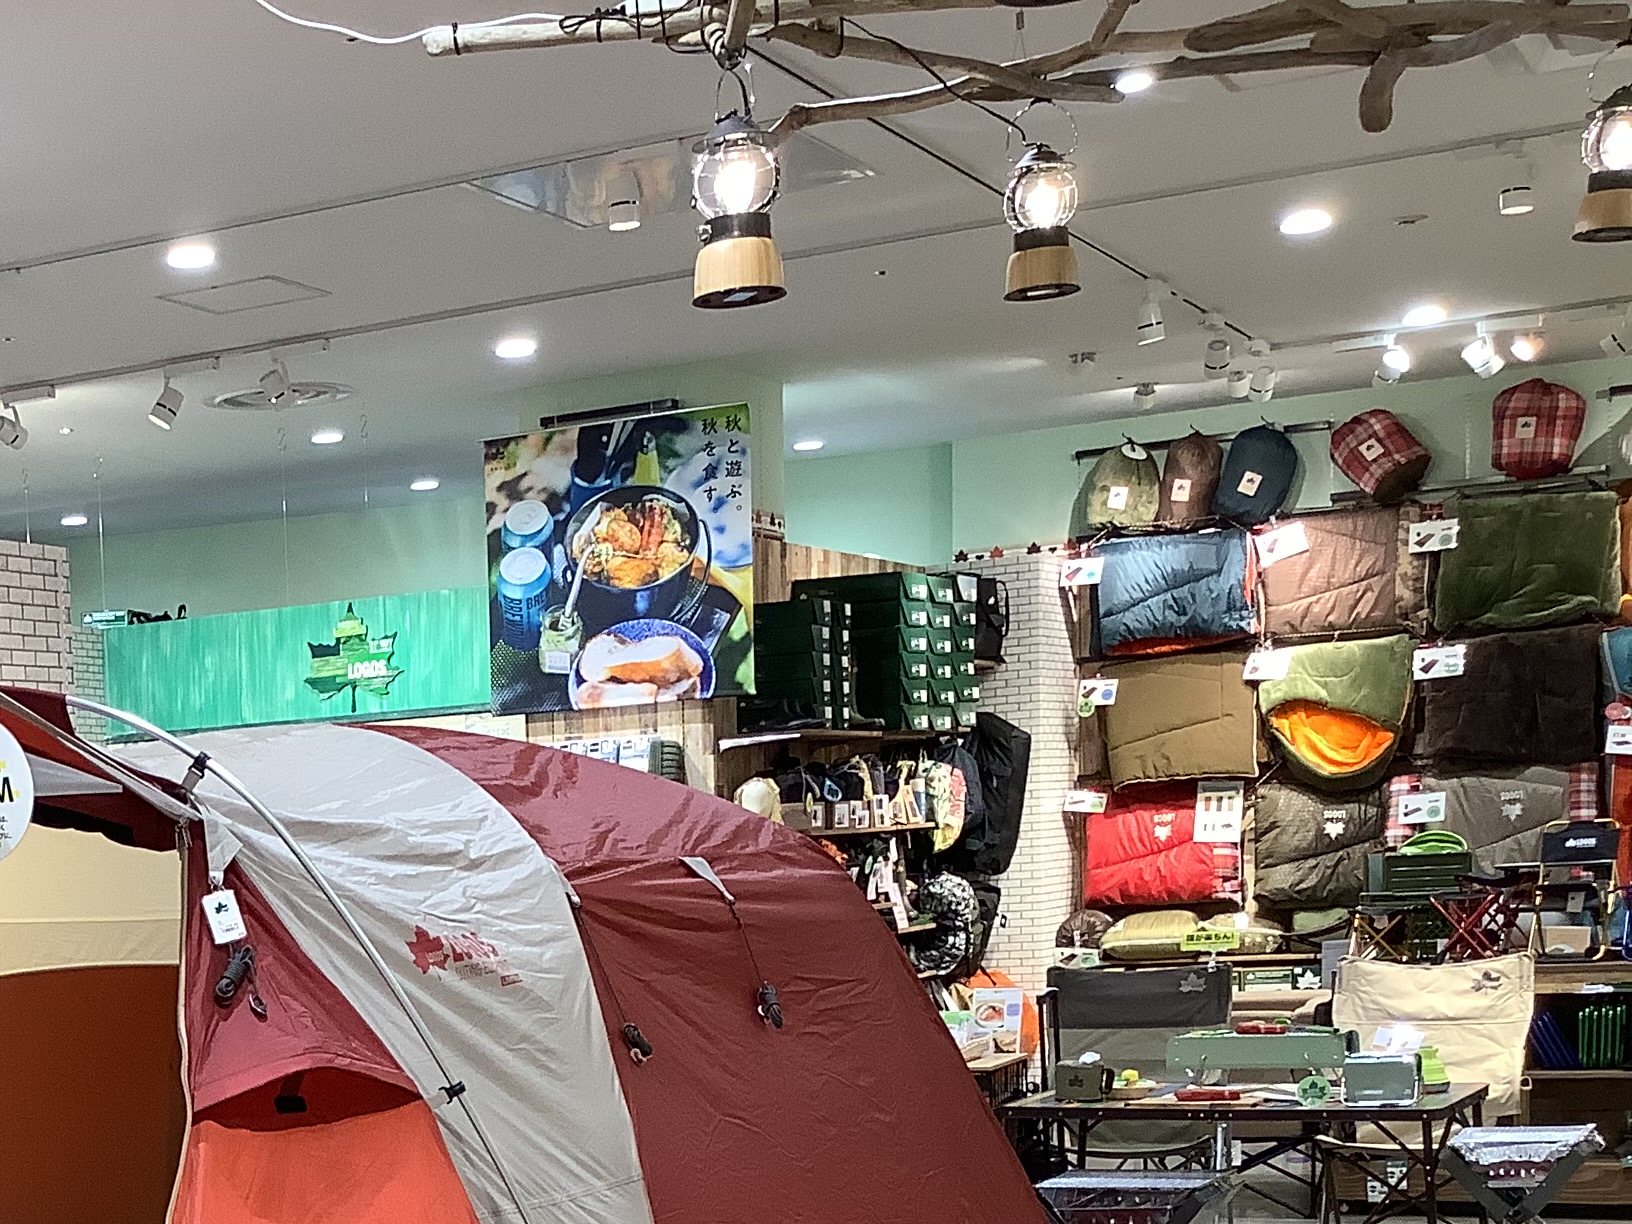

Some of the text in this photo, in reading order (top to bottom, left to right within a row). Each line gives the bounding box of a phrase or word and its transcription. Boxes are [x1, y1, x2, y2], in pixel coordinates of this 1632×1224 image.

[725, 414, 743, 511] 秋と遊ぶ。
[348, 659, 388, 680] LOGOS
[1323, 809, 1347, 819] LOGOS
